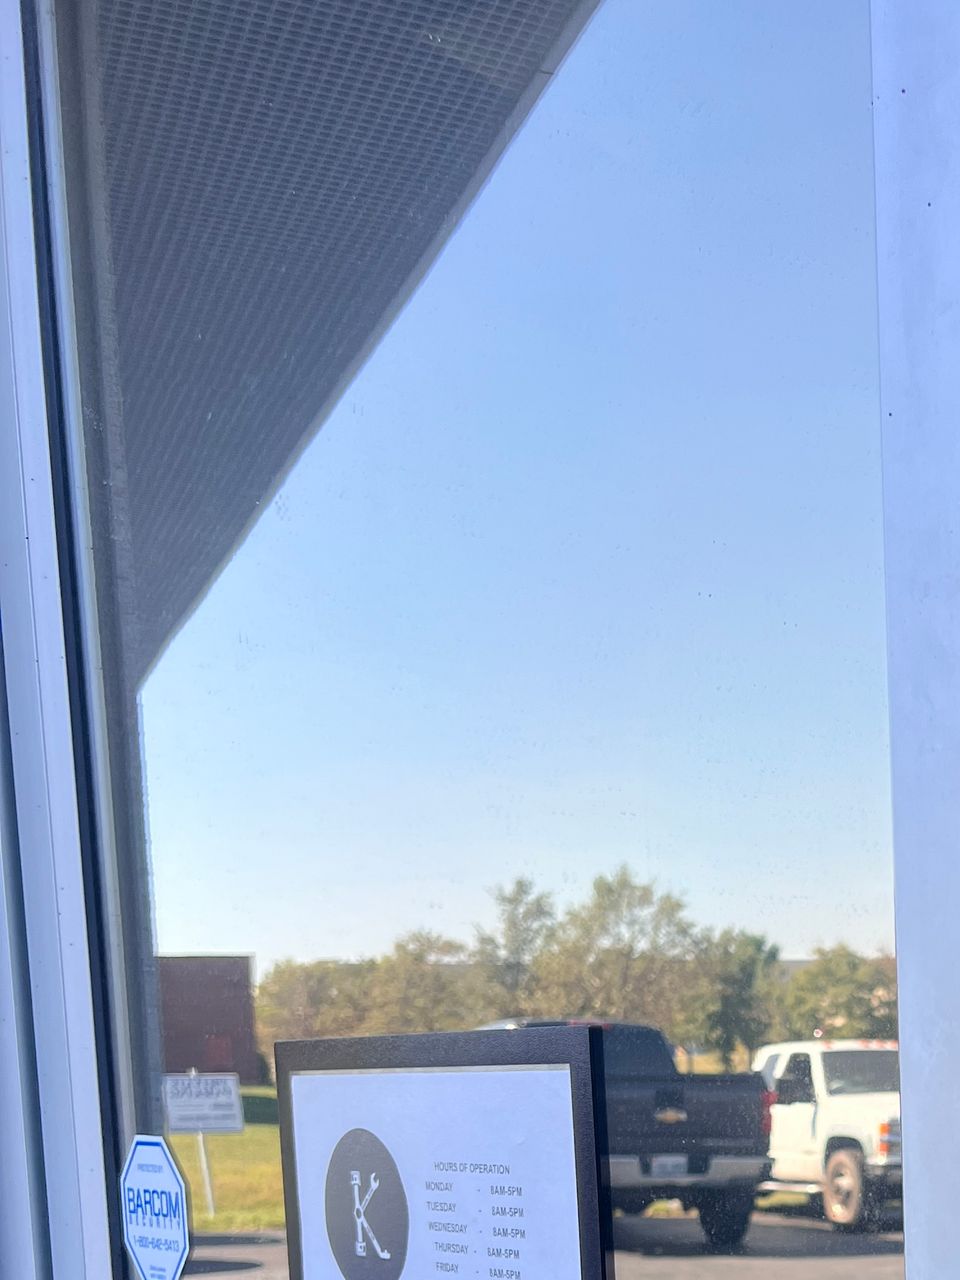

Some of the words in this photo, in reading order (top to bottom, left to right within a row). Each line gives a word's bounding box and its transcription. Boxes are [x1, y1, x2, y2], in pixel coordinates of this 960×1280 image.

[434, 1162, 458, 1172] HOURS
[459, 1163, 468, 1173] OF
[469, 1163, 510, 1175] OPERATION
[425, 1181, 453, 1192] MONDAY
[490, 1185, 522, 1197] 8AM-5PM
[127, 1187, 180, 1219] BARCOM
[427, 1201, 456, 1212] TUESDAY
[492, 1206, 524, 1217] 8AM-5PM
[428, 1222, 468, 1234] WEDNESDAY
[493, 1227, 526, 1239] 8AM-5PM
[434, 1242, 469, 1254] THURSDAY
[487, 1247, 520, 1259] 8AM-5PM
[435, 1262, 459, 1273] FRIDAY
[489, 1268, 521, 1280] 8AM-5PM
